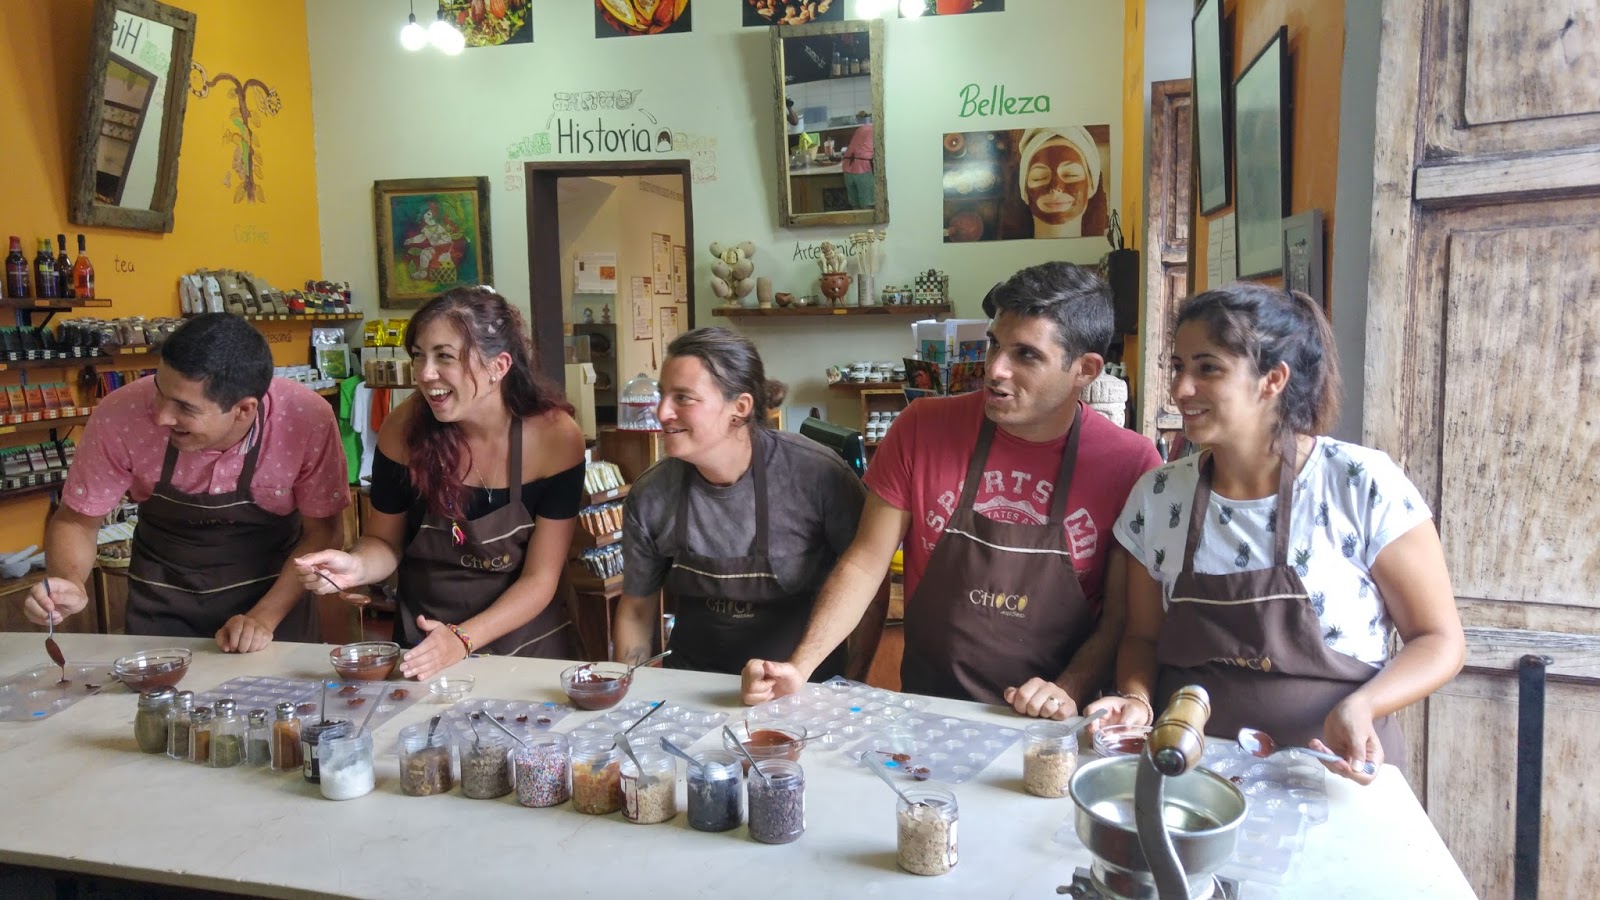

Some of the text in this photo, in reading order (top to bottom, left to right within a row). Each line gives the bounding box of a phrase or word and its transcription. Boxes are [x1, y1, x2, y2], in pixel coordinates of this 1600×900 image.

[958, 83, 1050, 118] Belleza
[557, 117, 651, 154] Historia
[114, 254, 135, 273] tea
[926, 470, 1055, 533] SPRTS
[985, 510, 1019, 520] TATES
[460, 553, 511, 570] CHOCO
[969, 588, 1029, 612] CHOCO
